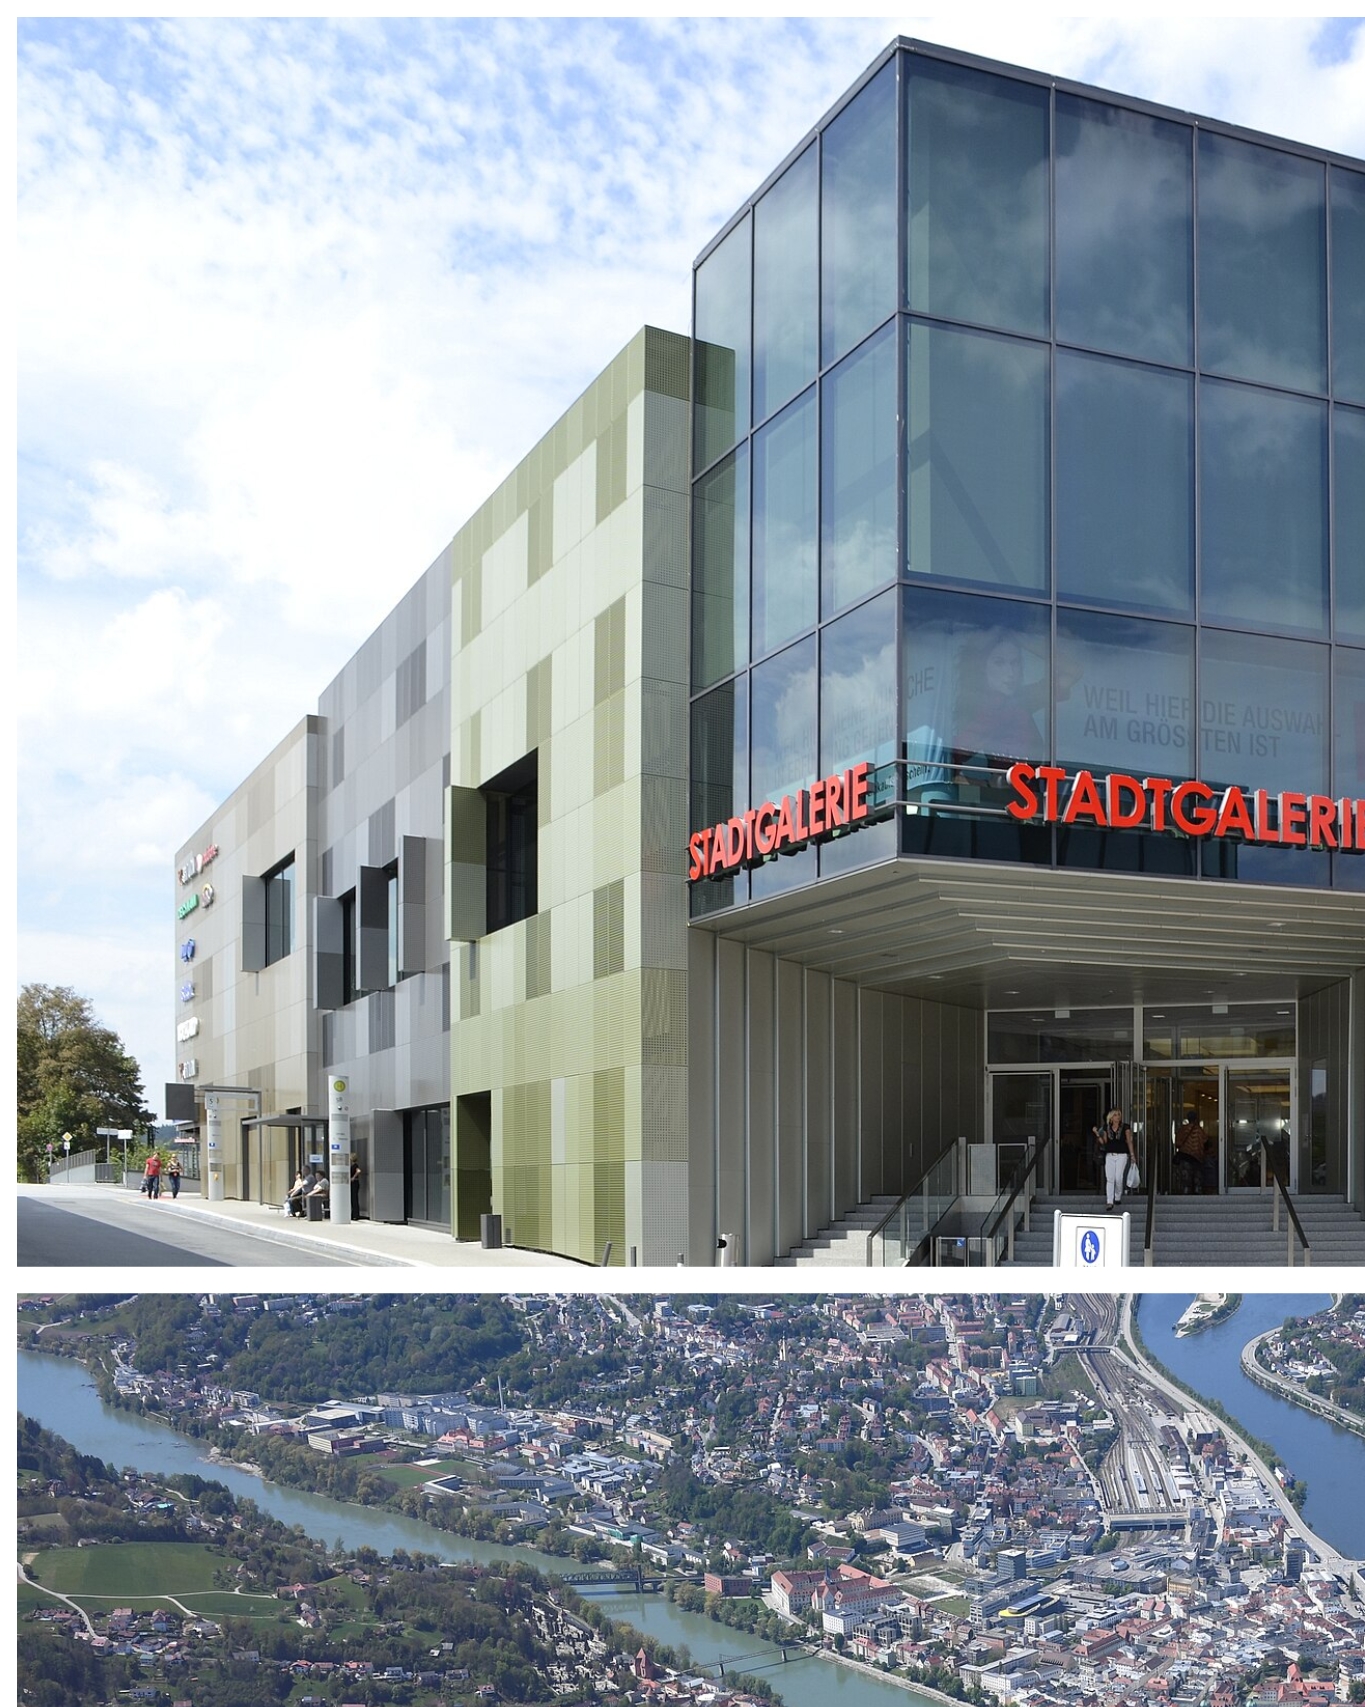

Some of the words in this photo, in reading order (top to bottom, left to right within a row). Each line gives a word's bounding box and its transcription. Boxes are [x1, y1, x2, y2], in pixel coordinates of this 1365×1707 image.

[1084, 685, 1138, 713] WEIL
[1203, 700, 1236, 726] DIE
[1084, 714, 1118, 741] AM
[1249, 736, 1281, 758] IST
[689, 762, 873, 881] STADTGALERIE
